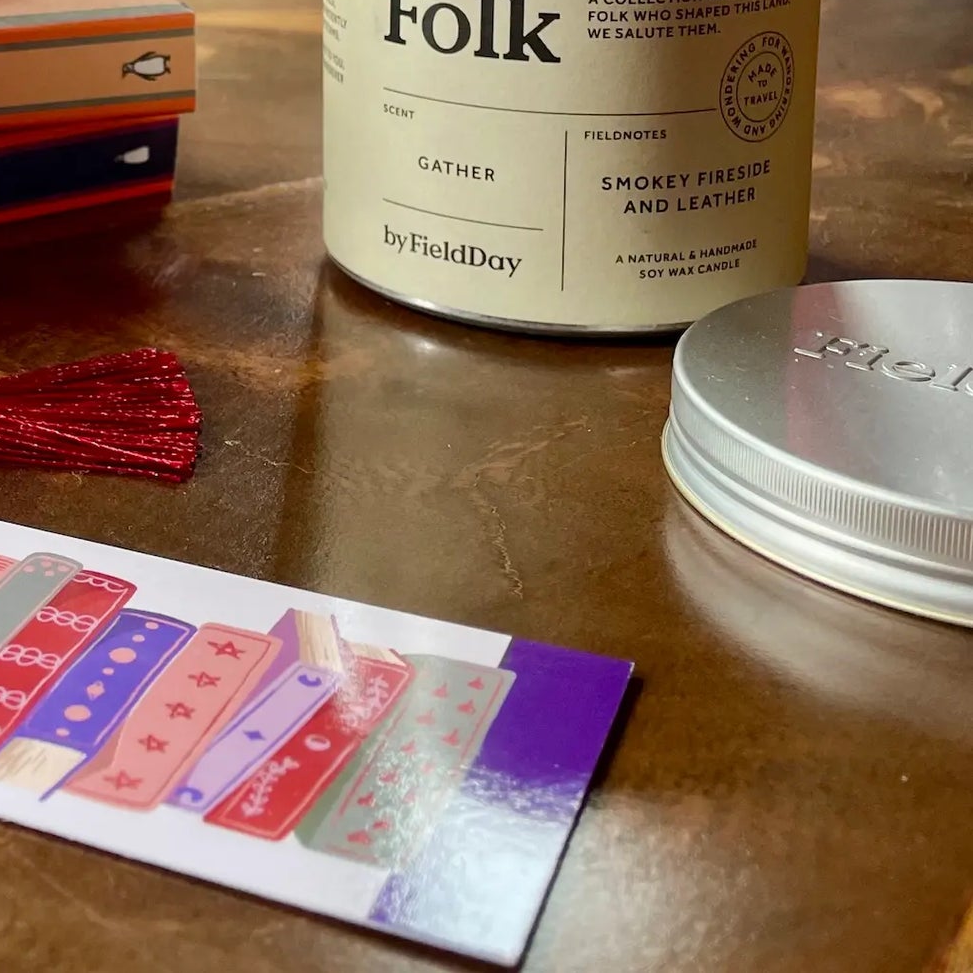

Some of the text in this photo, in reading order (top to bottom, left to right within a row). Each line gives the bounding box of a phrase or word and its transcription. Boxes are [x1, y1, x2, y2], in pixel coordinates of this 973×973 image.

[588, 10, 629, 22] FOLK
[634, 9, 671, 21] WHO
[675, 5, 730, 20] SHAPED
[734, 0, 760, 14] THIS
[588, 23, 722, 39] WE SALUTE THEM.
[762, 36, 780, 49] FOR
[748, 63, 777, 83] MADE
[724, 42, 756, 129] WONDERING
[757, 80, 768, 88] TO
[744, 91, 778, 106] TRAVEL
[383, 103, 415, 119] SCENT
[584, 129, 667, 140] FIELDNOTES
[744, 125, 766, 136] AND
[418, 156, 496, 182] GATHER
[601, 159, 771, 191] SMOKEY FIRESIDE
[623, 187, 756, 214] AND LEATHER
[615, 239, 758, 264] A NATURAL & HANDMADE
[639, 258, 740, 279] SOY WAX CANDLE
[793, 336, 973, 397] Fiel
